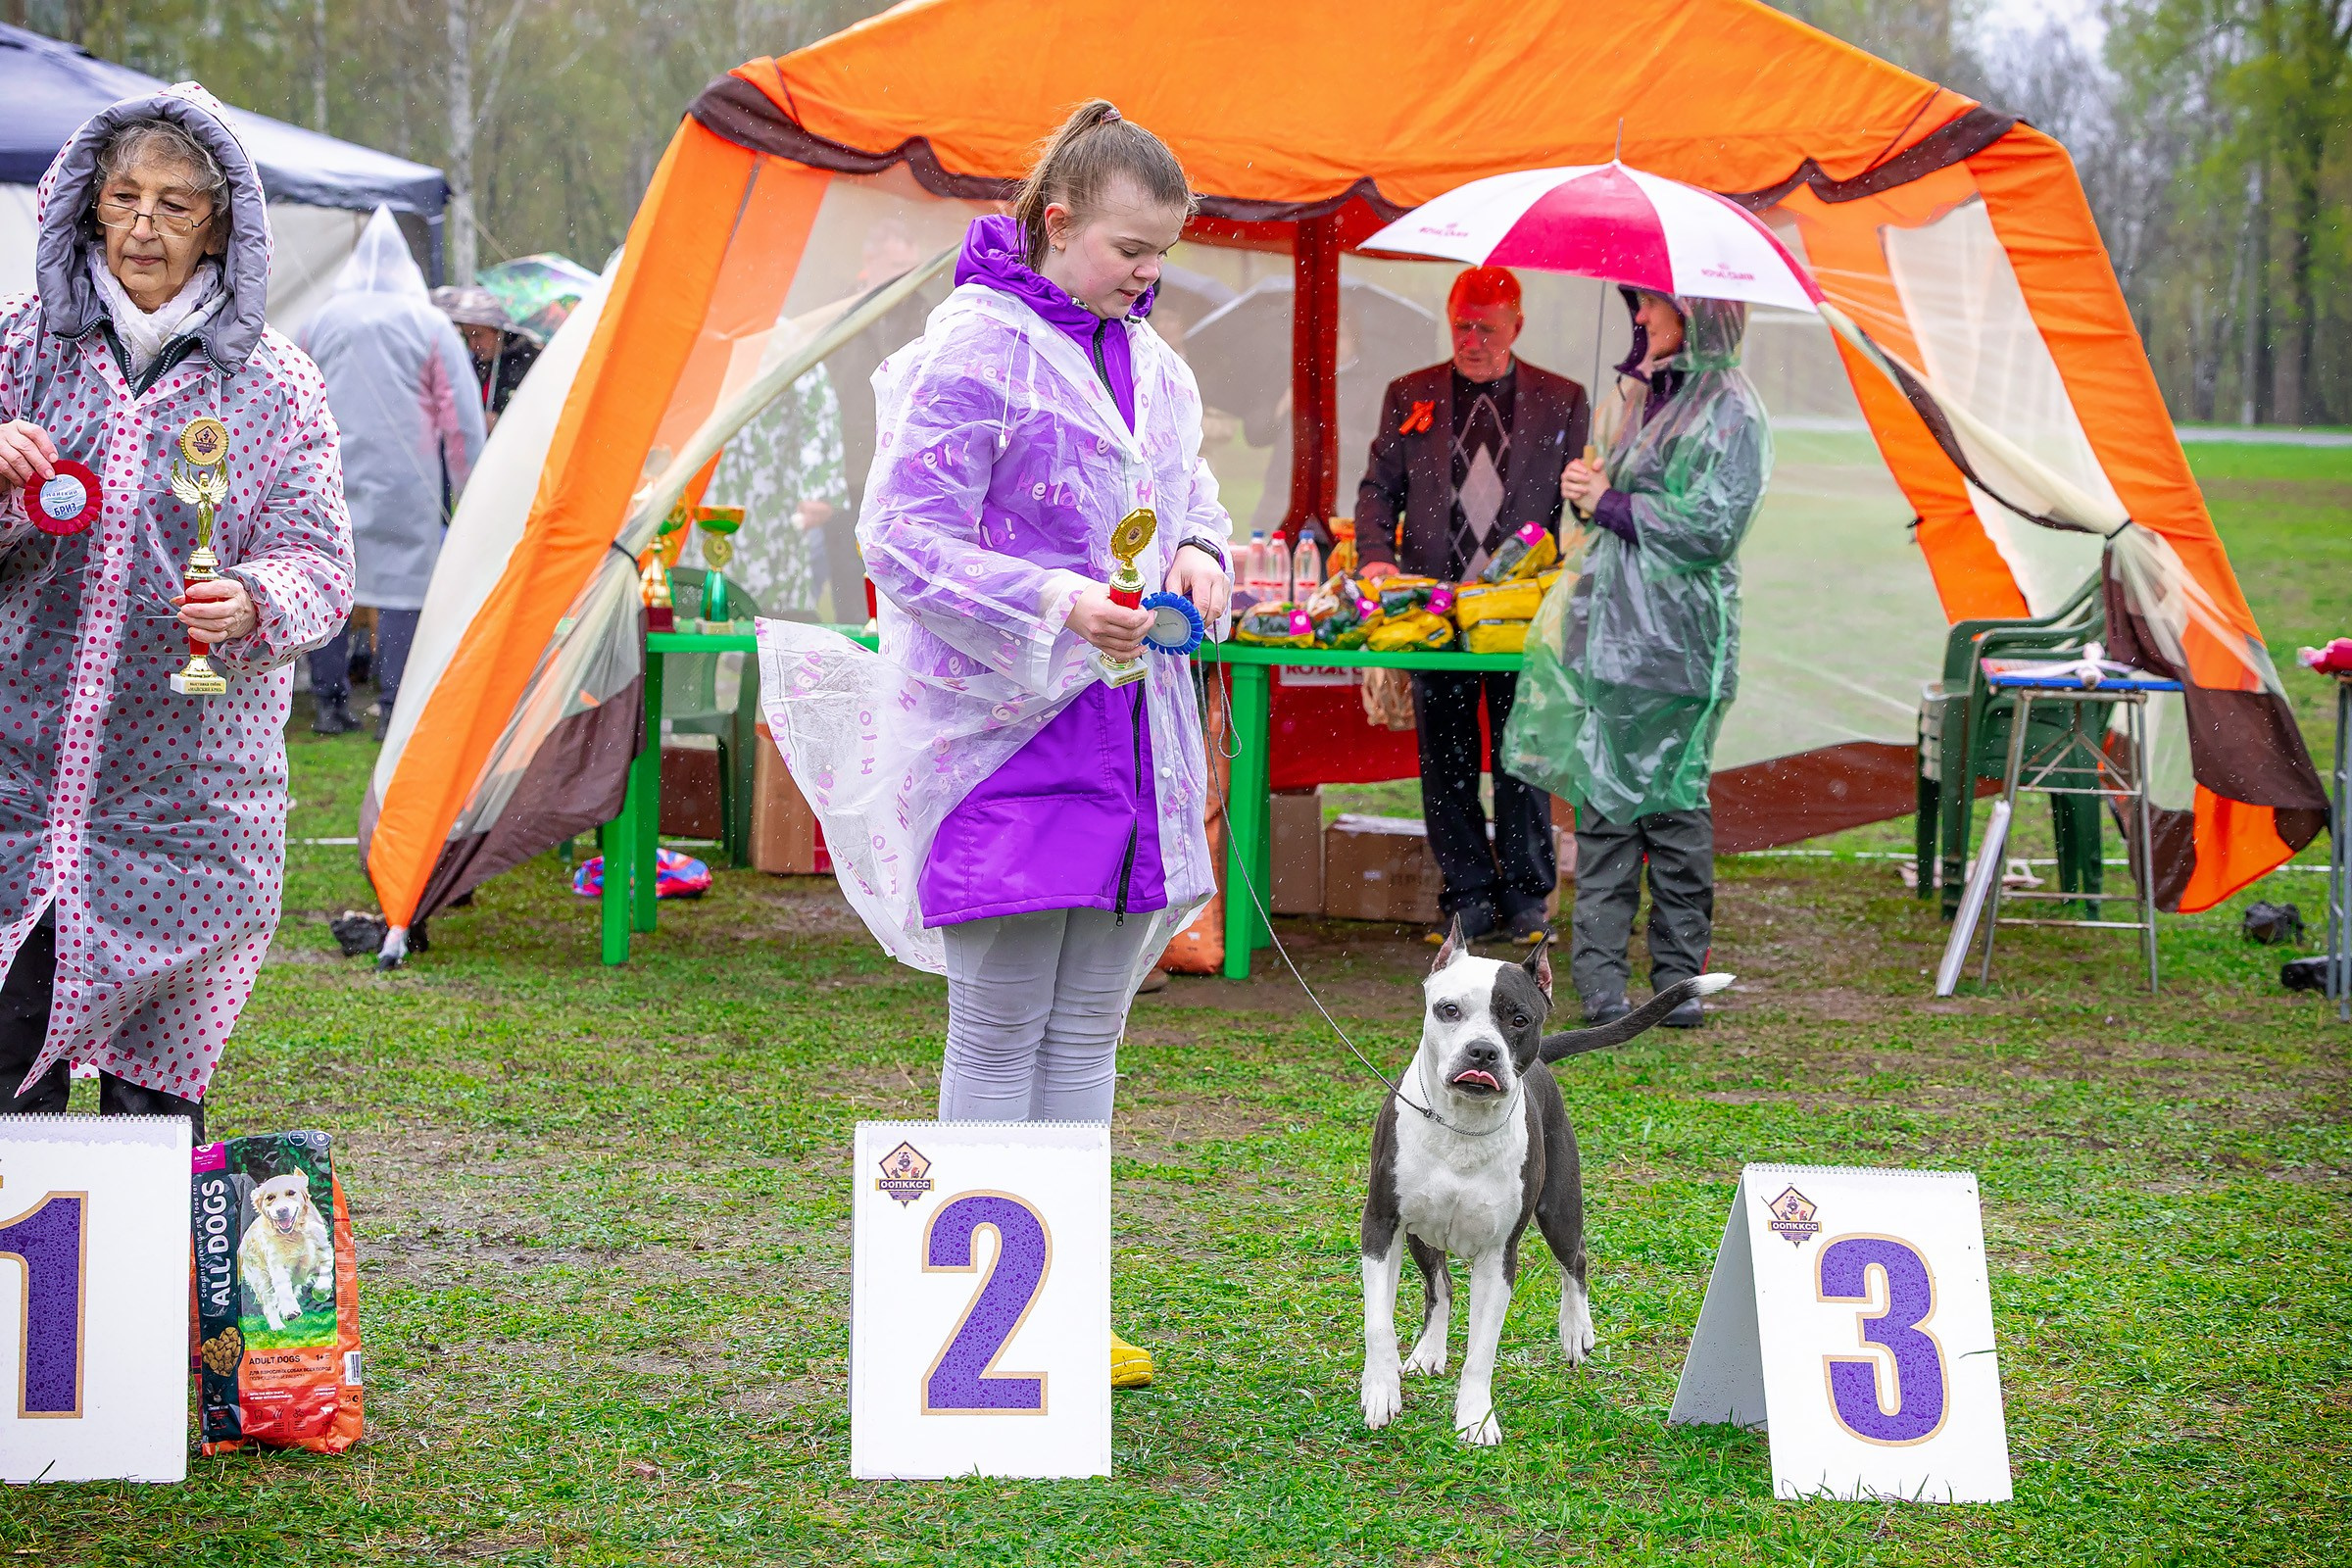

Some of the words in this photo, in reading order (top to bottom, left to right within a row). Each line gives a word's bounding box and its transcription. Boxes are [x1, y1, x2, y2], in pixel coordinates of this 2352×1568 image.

[54, 503, 77, 516] БРИЗ
[1016, 471, 1086, 514] Hello!
[880, 1180, 930, 1190] ООПККСС
[201, 1179, 229, 1254] DOGS
[1772, 1222, 1818, 1232] ООПККСС
[211, 1257, 231, 1306] ALL
[921, 1189, 1053, 1416] 2
[0, 1191, 88, 1419] 1
[249, 1356, 275, 1365] ADULT
[276, 1354, 301, 1363] DOGS
[1814, 1232, 1950, 1448] 3
